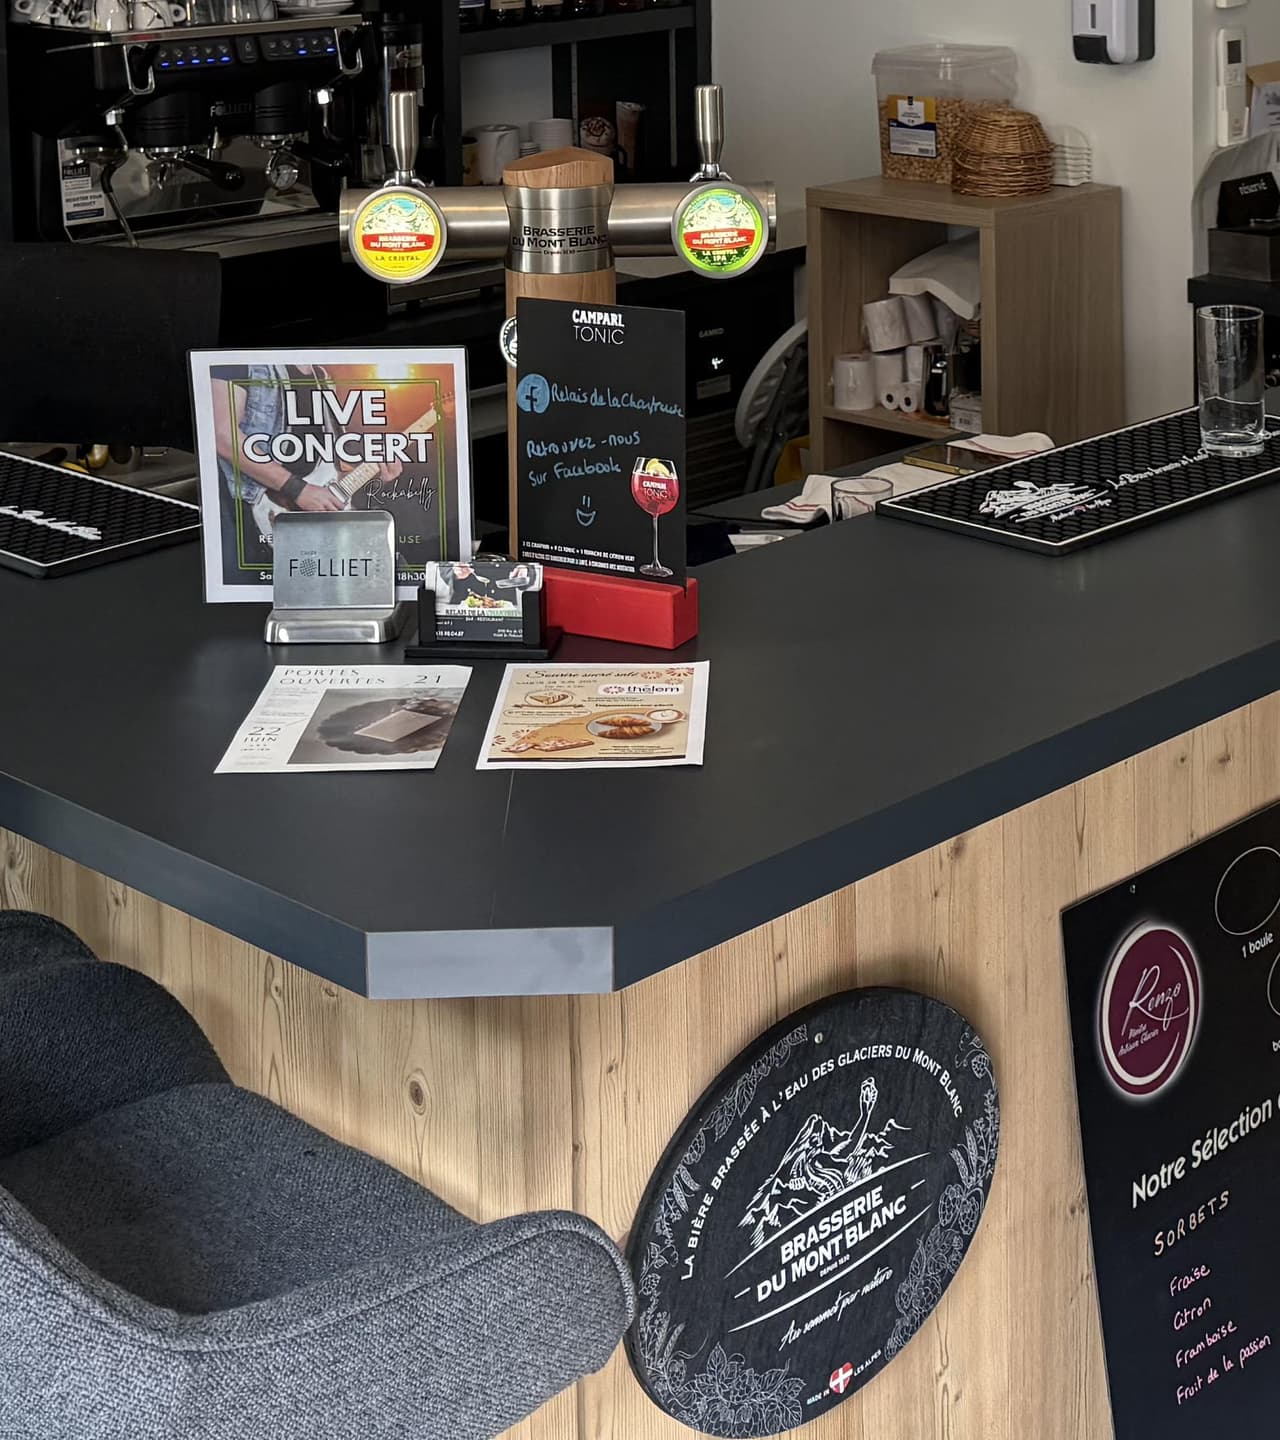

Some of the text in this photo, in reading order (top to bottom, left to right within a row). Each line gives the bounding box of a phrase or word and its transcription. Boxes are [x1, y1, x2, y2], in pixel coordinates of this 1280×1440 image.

[511, 235, 608, 249] DU MONT BLANC
[523, 225, 595, 237] BRASSERIE
[572, 309, 625, 327] CAMPARI
[573, 325, 625, 345] TONIC
[284, 389, 387, 426] LIVE
[551, 383, 588, 404] Relais
[590, 389, 606, 406] de
[607, 387, 621, 408] la
[242, 432, 434, 464] CONCERT
[553, 457, 622, 480] Facebook
[279, 677, 387, 686] OUVERTES
[282, 668, 360, 677] PORTES
[1248, 931, 1274, 956] boule
[681, 1044, 963, 1280] LA BIÈRE BRASSÉE À L'EAU DES GLACIERS DU MONT BLANC
[1131, 1155, 1186, 1209] Notre
[1190, 1098, 1273, 1169] Sélection
[780, 1185, 884, 1265] BRASSERIE
[757, 1195, 907, 1303] DU MONT BLANC
[1168, 1263, 1211, 1297] Fraise
[1172, 1296, 1212, 1332] Citron
[1174, 1319, 1239, 1369] Framboise
[853, 1365, 865, 1377] LES
[864, 1349, 883, 1368] ALPES
[1175, 1333, 1272, 1406] Fruit de la passion
